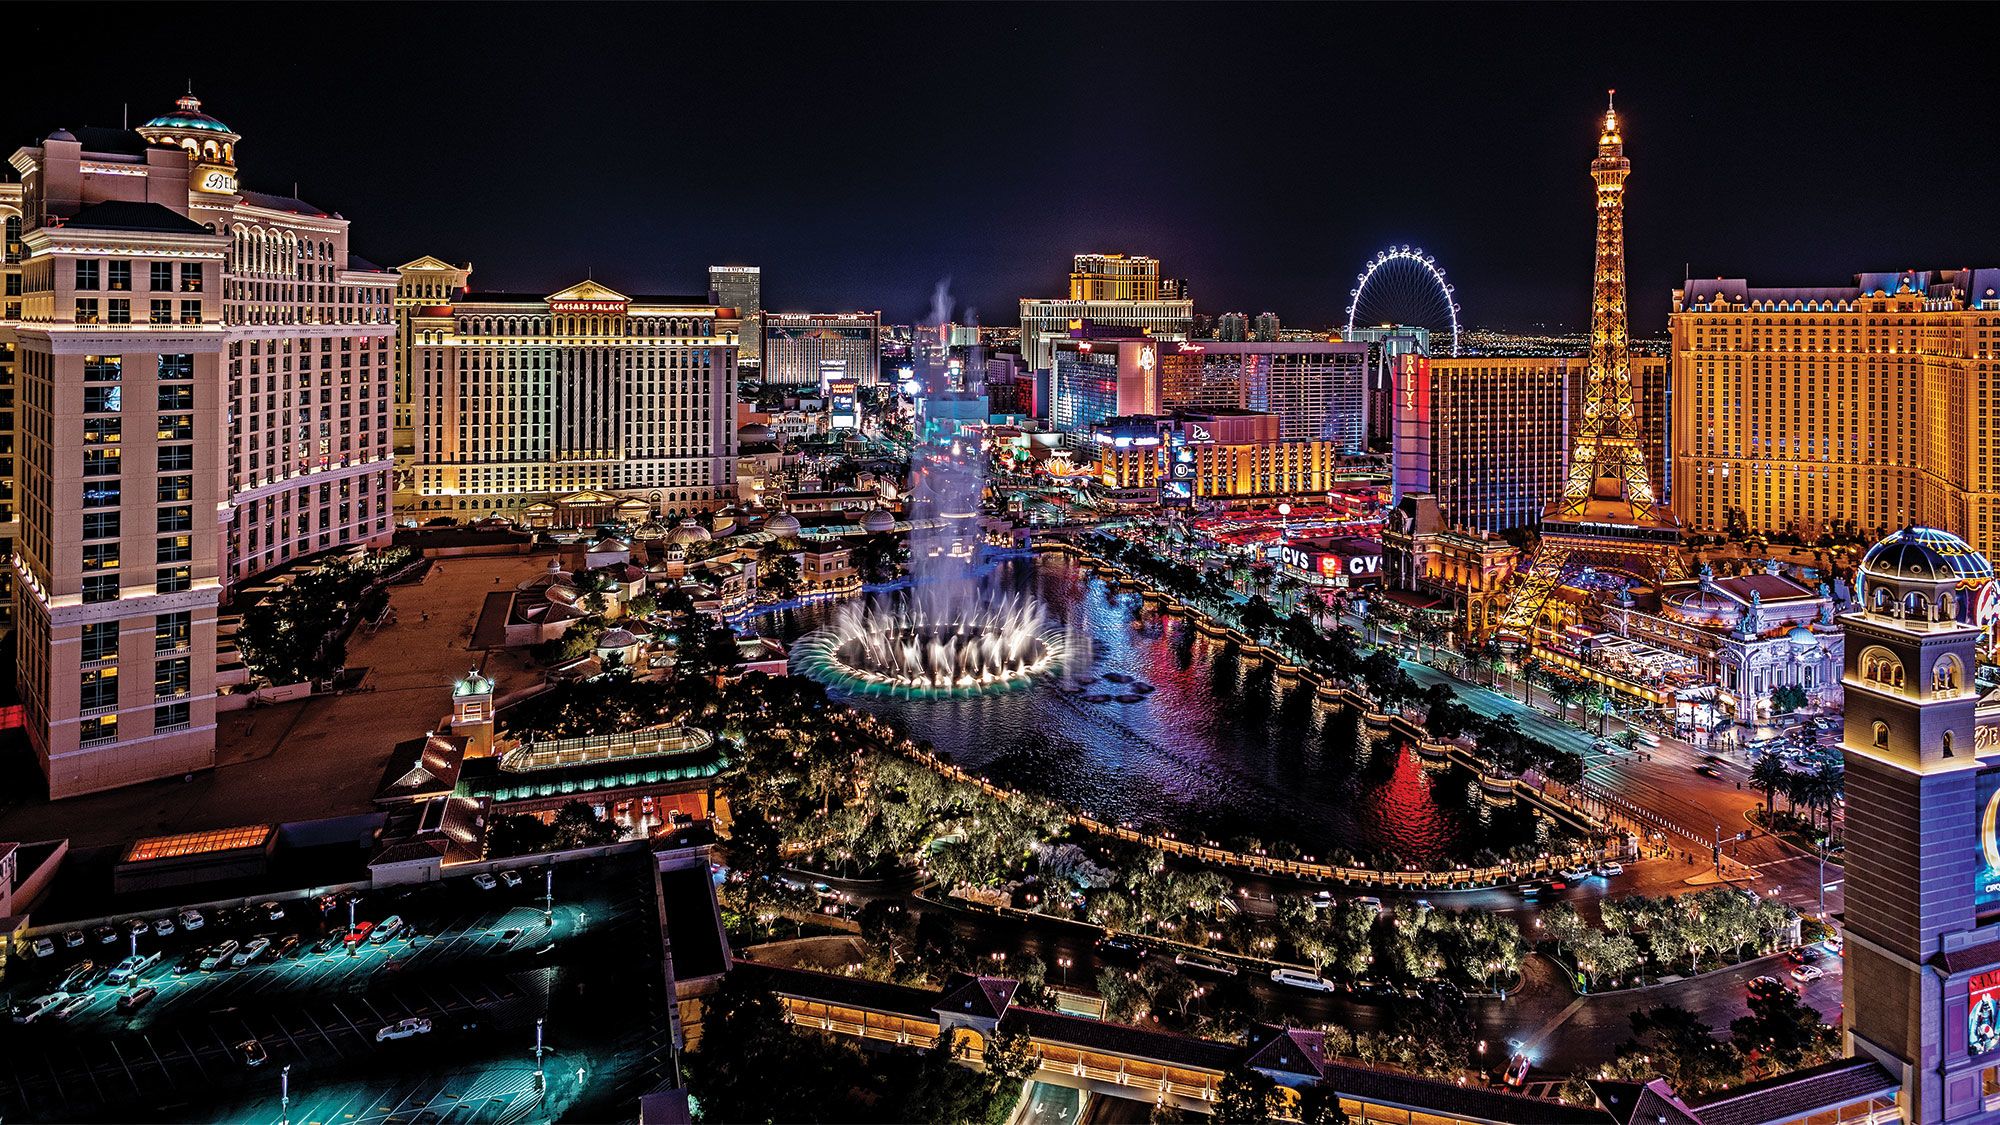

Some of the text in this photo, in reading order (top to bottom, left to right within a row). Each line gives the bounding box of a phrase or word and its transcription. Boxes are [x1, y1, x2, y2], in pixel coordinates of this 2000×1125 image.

[552, 303, 624, 311] CAESARS PALACE
[1282, 546, 1309, 569] CVS
